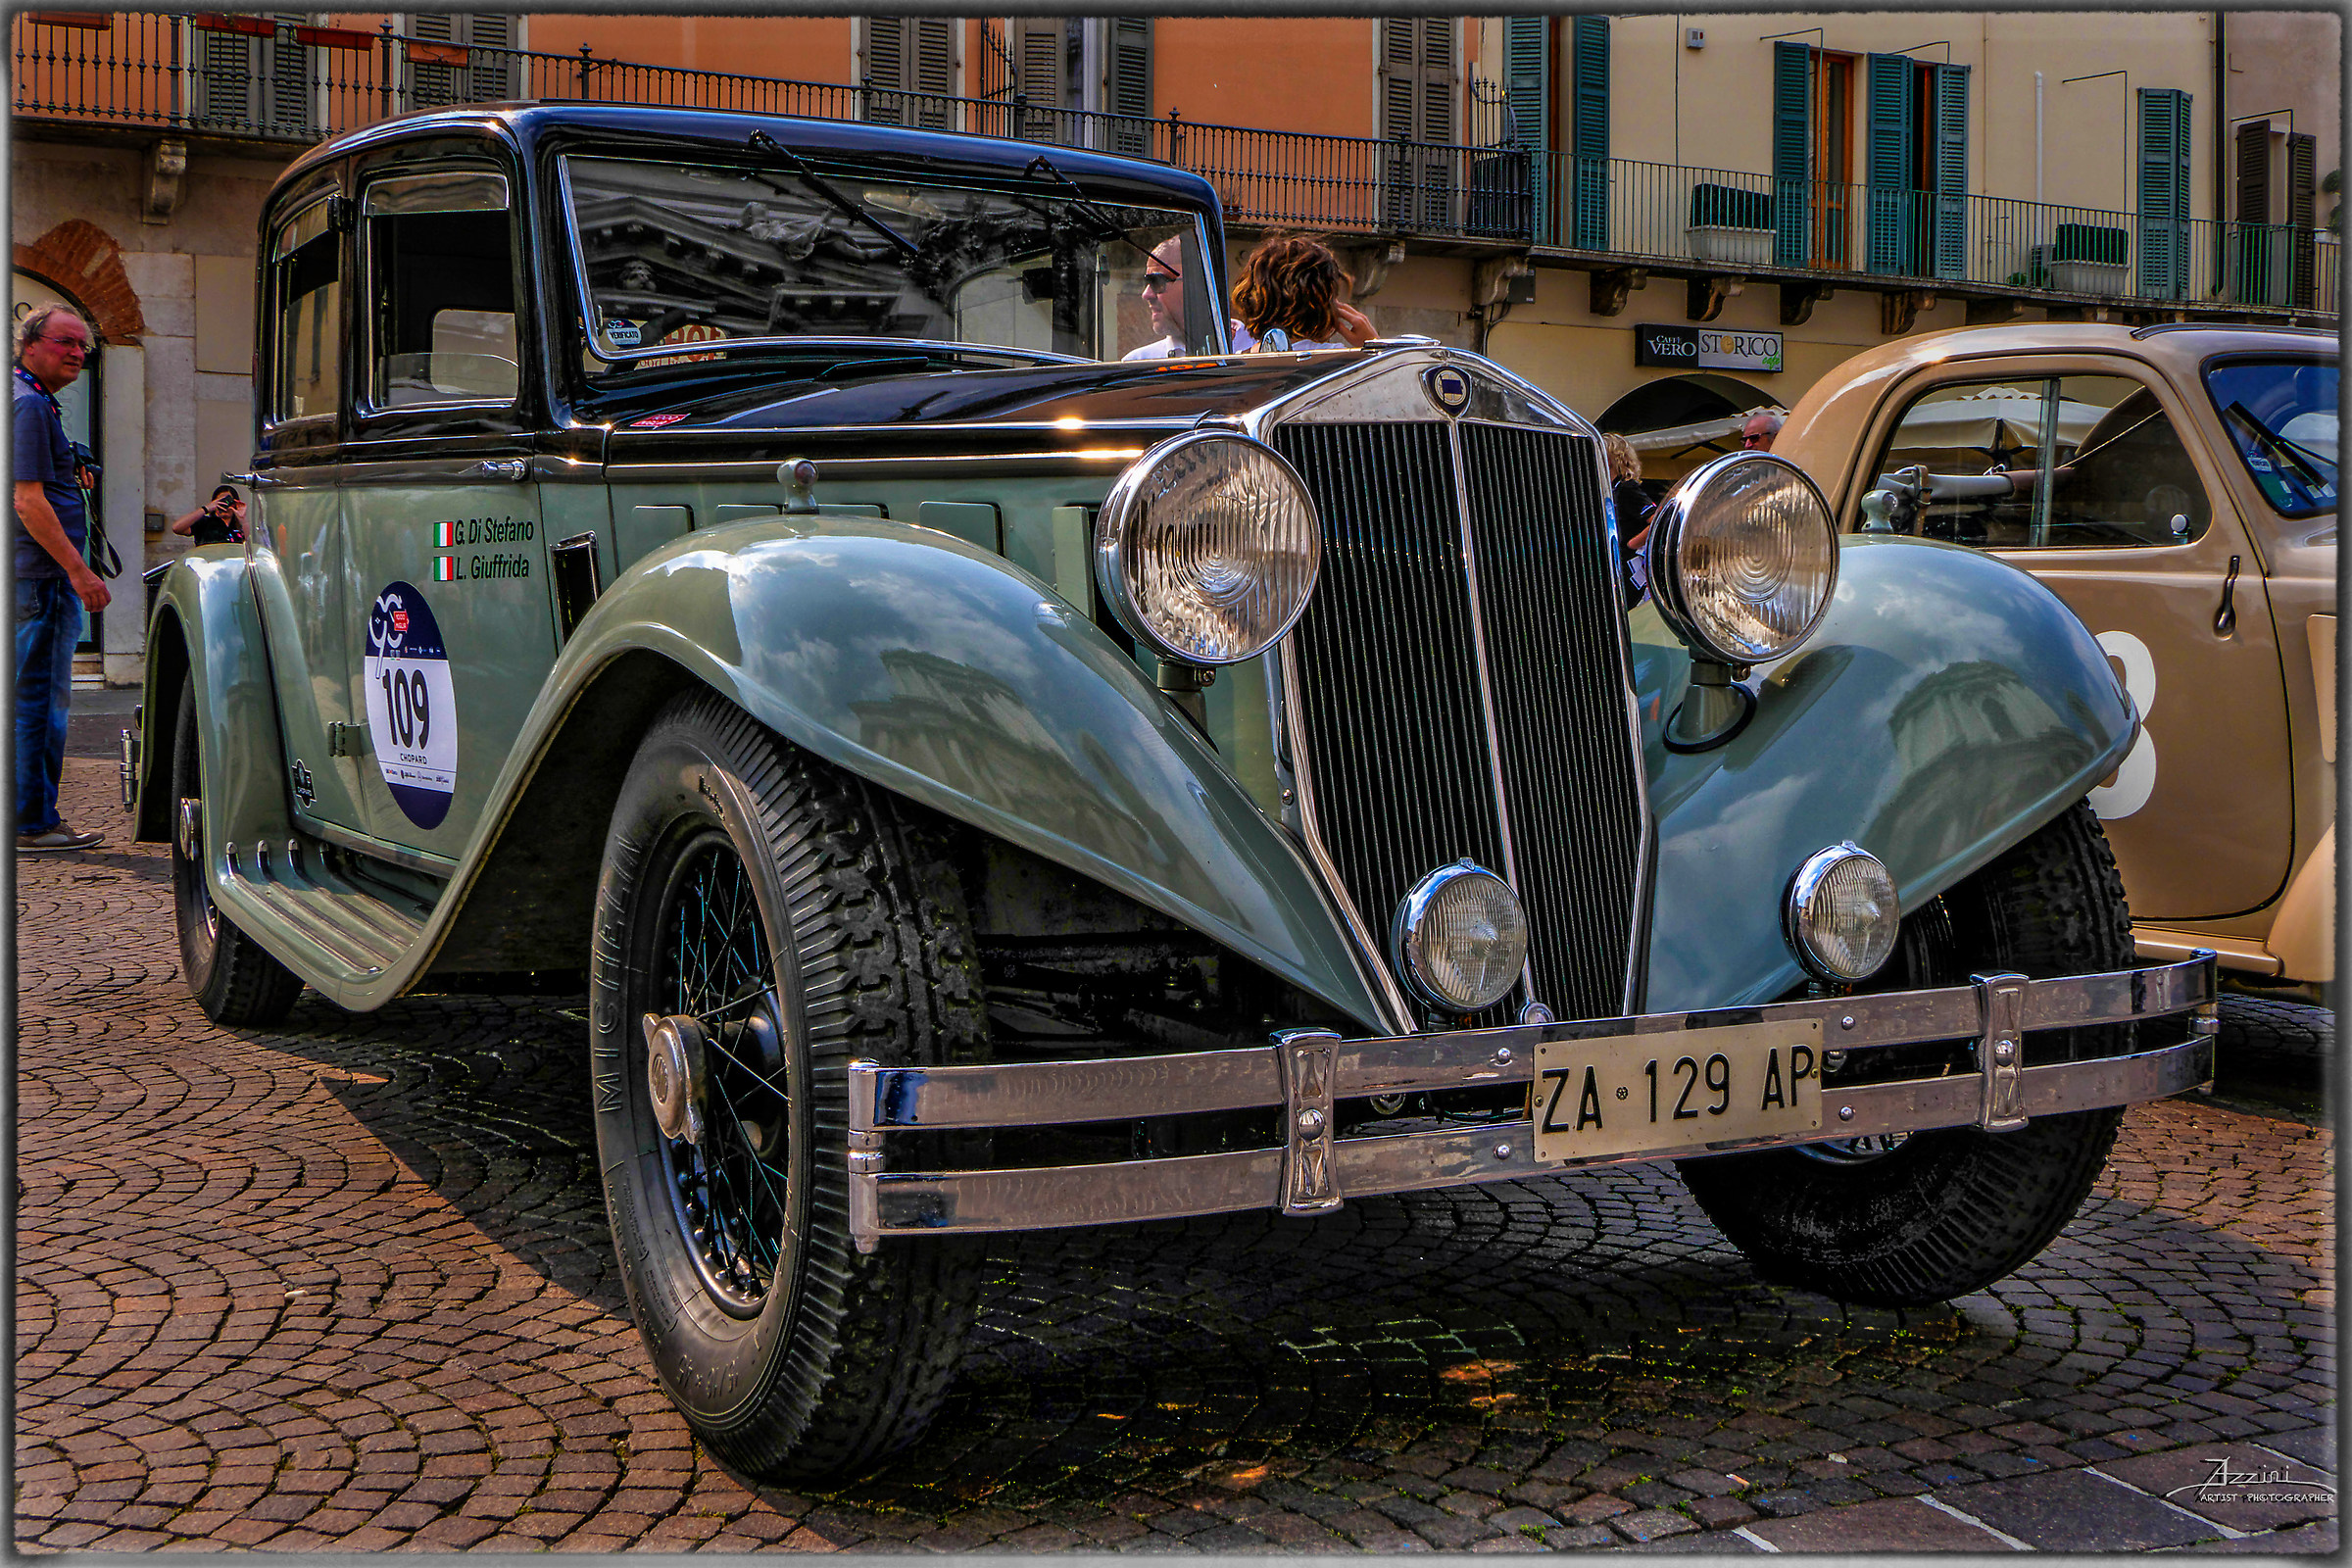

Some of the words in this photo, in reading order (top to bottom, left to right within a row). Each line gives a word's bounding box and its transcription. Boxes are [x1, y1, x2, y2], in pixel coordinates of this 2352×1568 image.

[1647, 339, 1696, 356] VERO
[1701, 334, 1779, 357] STORICO
[455, 519, 466, 545] G.
[468, 518, 482, 545] Di
[484, 515, 534, 543] Stefano
[457, 557, 466, 580] L.
[470, 554, 529, 579] Giuffrida
[382, 668, 430, 750] 109
[400, 753, 427, 764] CHOPARD
[594, 823, 643, 1113] MICHELIN
[1542, 1066, 1602, 1134] ZA
[1644, 1053, 1730, 1122] 129
[1761, 1045, 1814, 1110] AP
